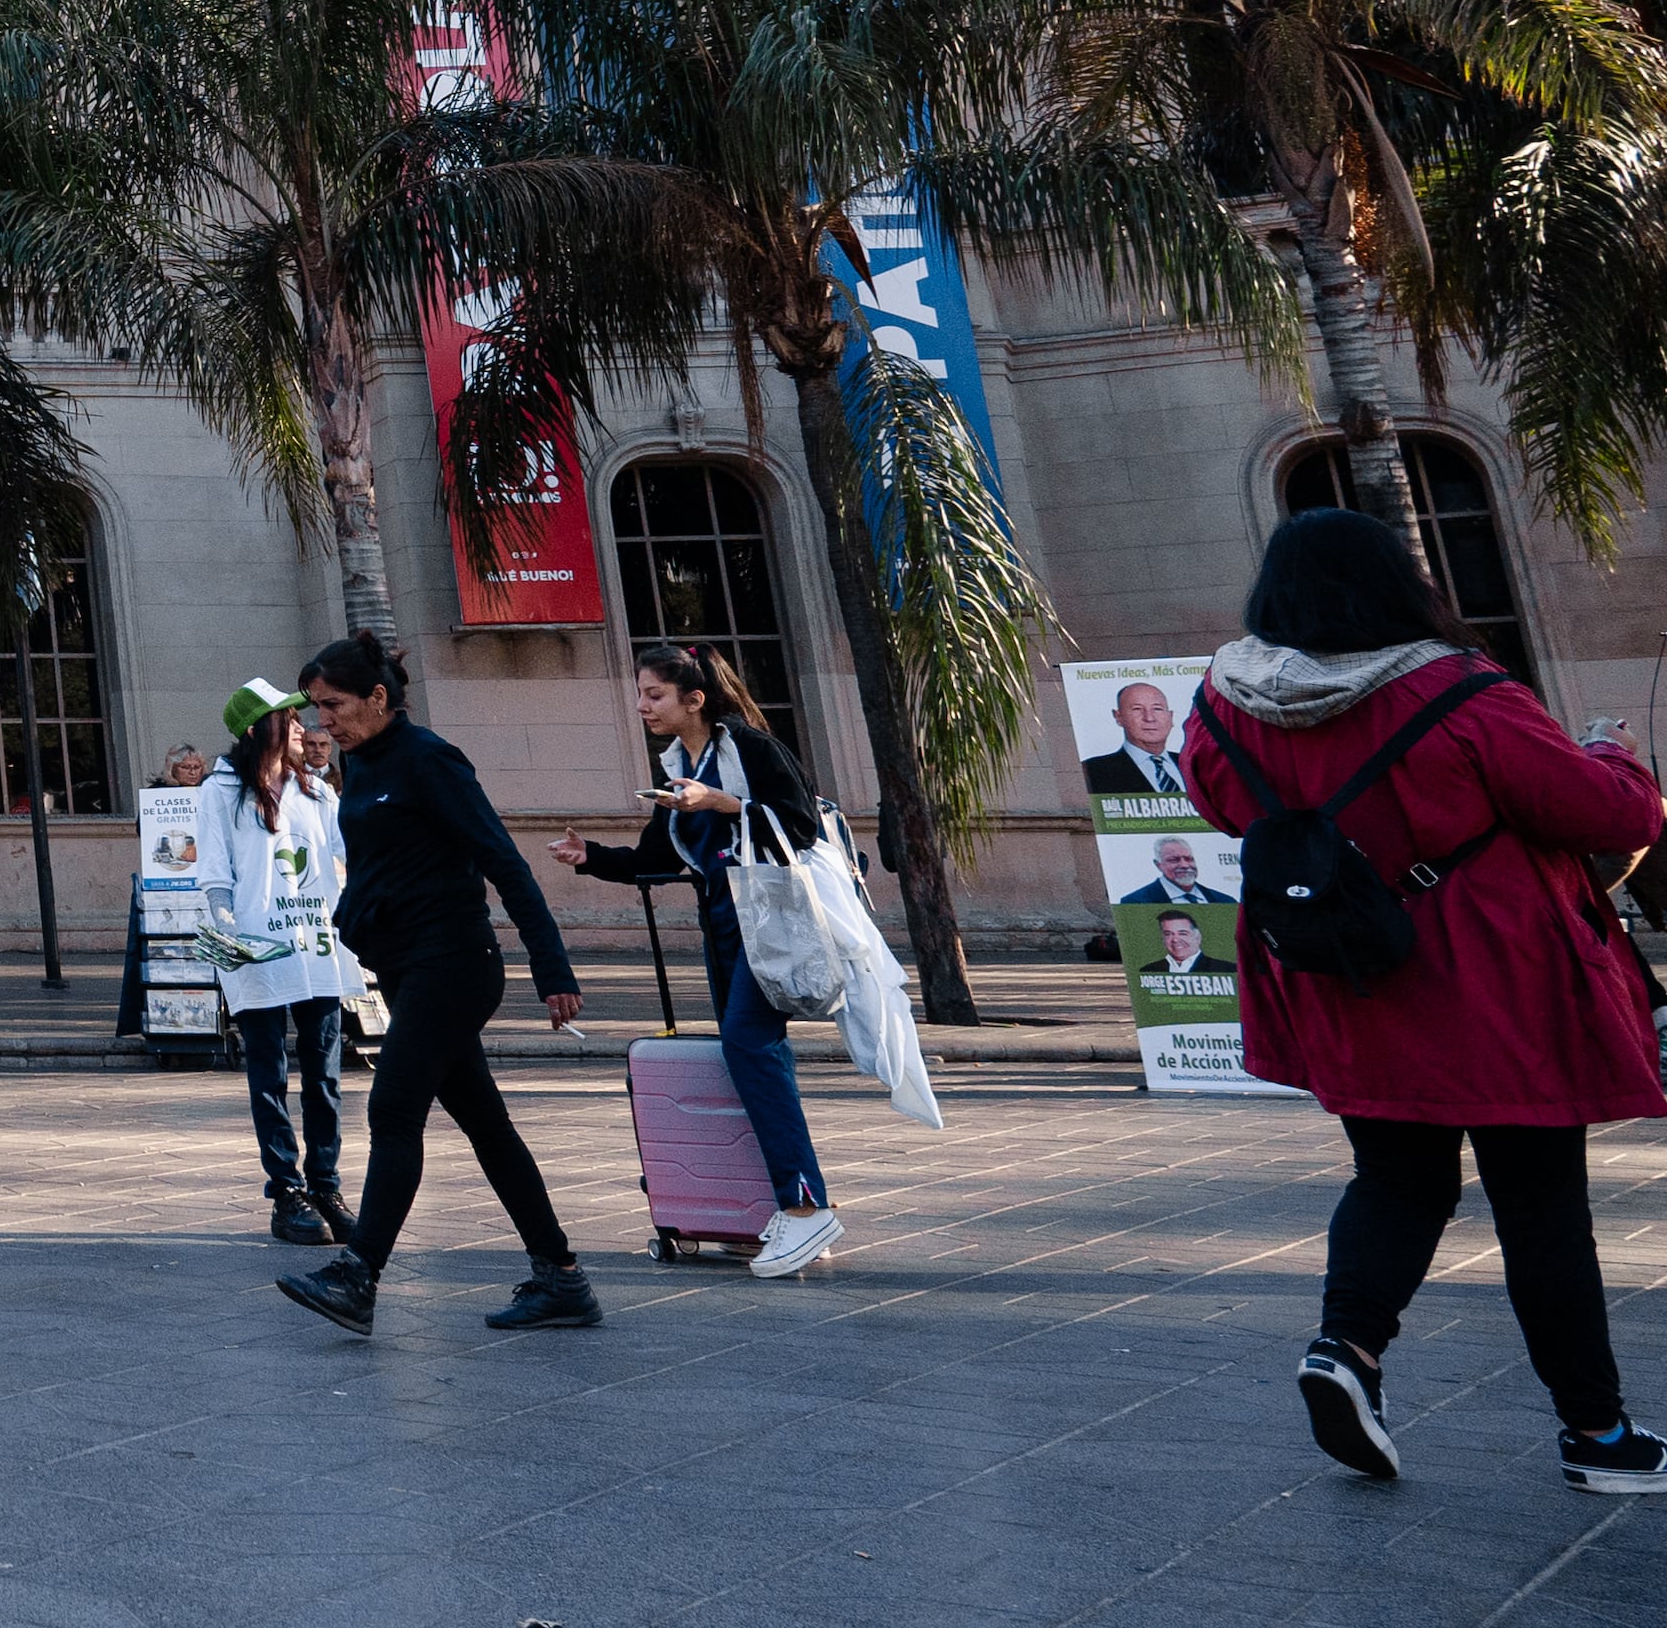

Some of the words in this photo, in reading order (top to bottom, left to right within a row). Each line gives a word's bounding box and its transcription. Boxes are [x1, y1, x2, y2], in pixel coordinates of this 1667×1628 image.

[520, 570, 574, 581] BUENO!
[1076, 669, 1115, 680] Nuevas
[1152, 665, 1174, 677] Más
[154, 798, 191, 806] CLASES
[156, 816, 191, 824] GRATIS
[268, 917, 283, 932] de
[1140, 975, 1165, 988] JORGE
[1166, 976, 1236, 996] ESTEBAN
[1157, 1053, 1176, 1068] de
[1181, 1053, 1232, 1070] Acción
